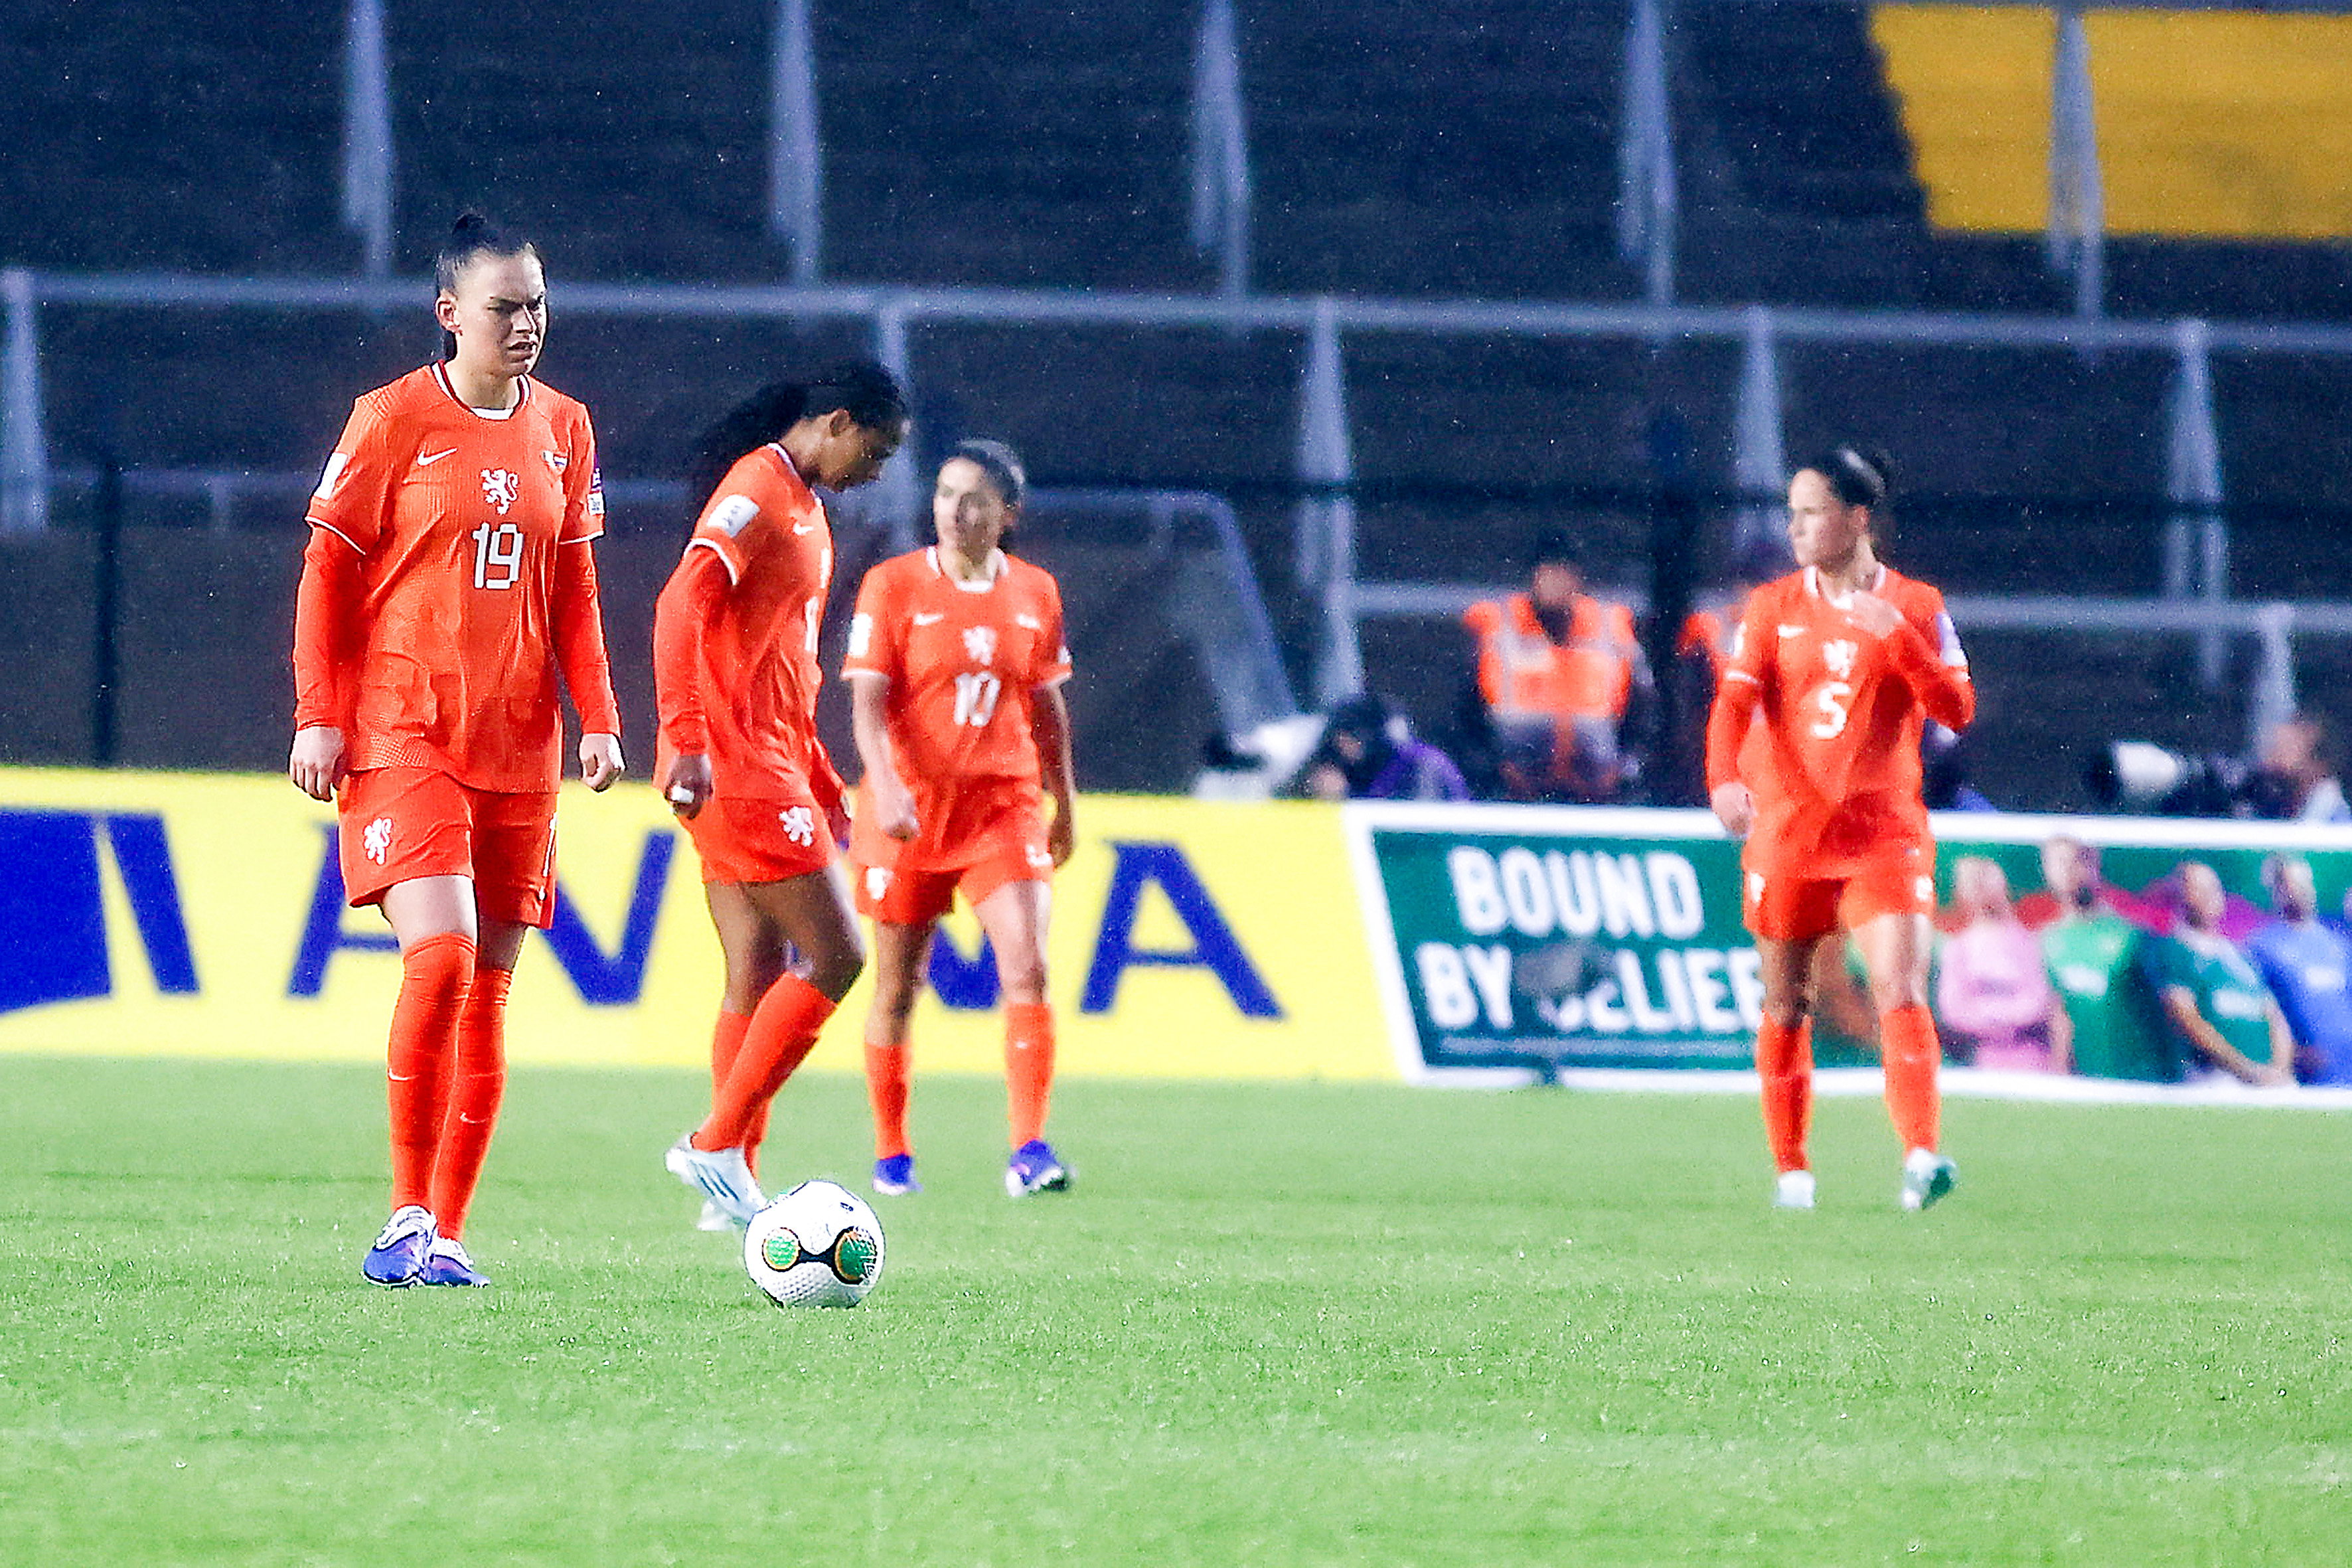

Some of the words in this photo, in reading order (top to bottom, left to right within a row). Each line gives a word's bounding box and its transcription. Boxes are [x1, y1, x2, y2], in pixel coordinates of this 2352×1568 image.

[472, 522, 524, 589] 19
[953, 670, 1000, 728] 10
[1810, 681, 1851, 740] 5
[1448, 845, 1705, 939] BOUND
[1415, 941, 1514, 1029] BY
